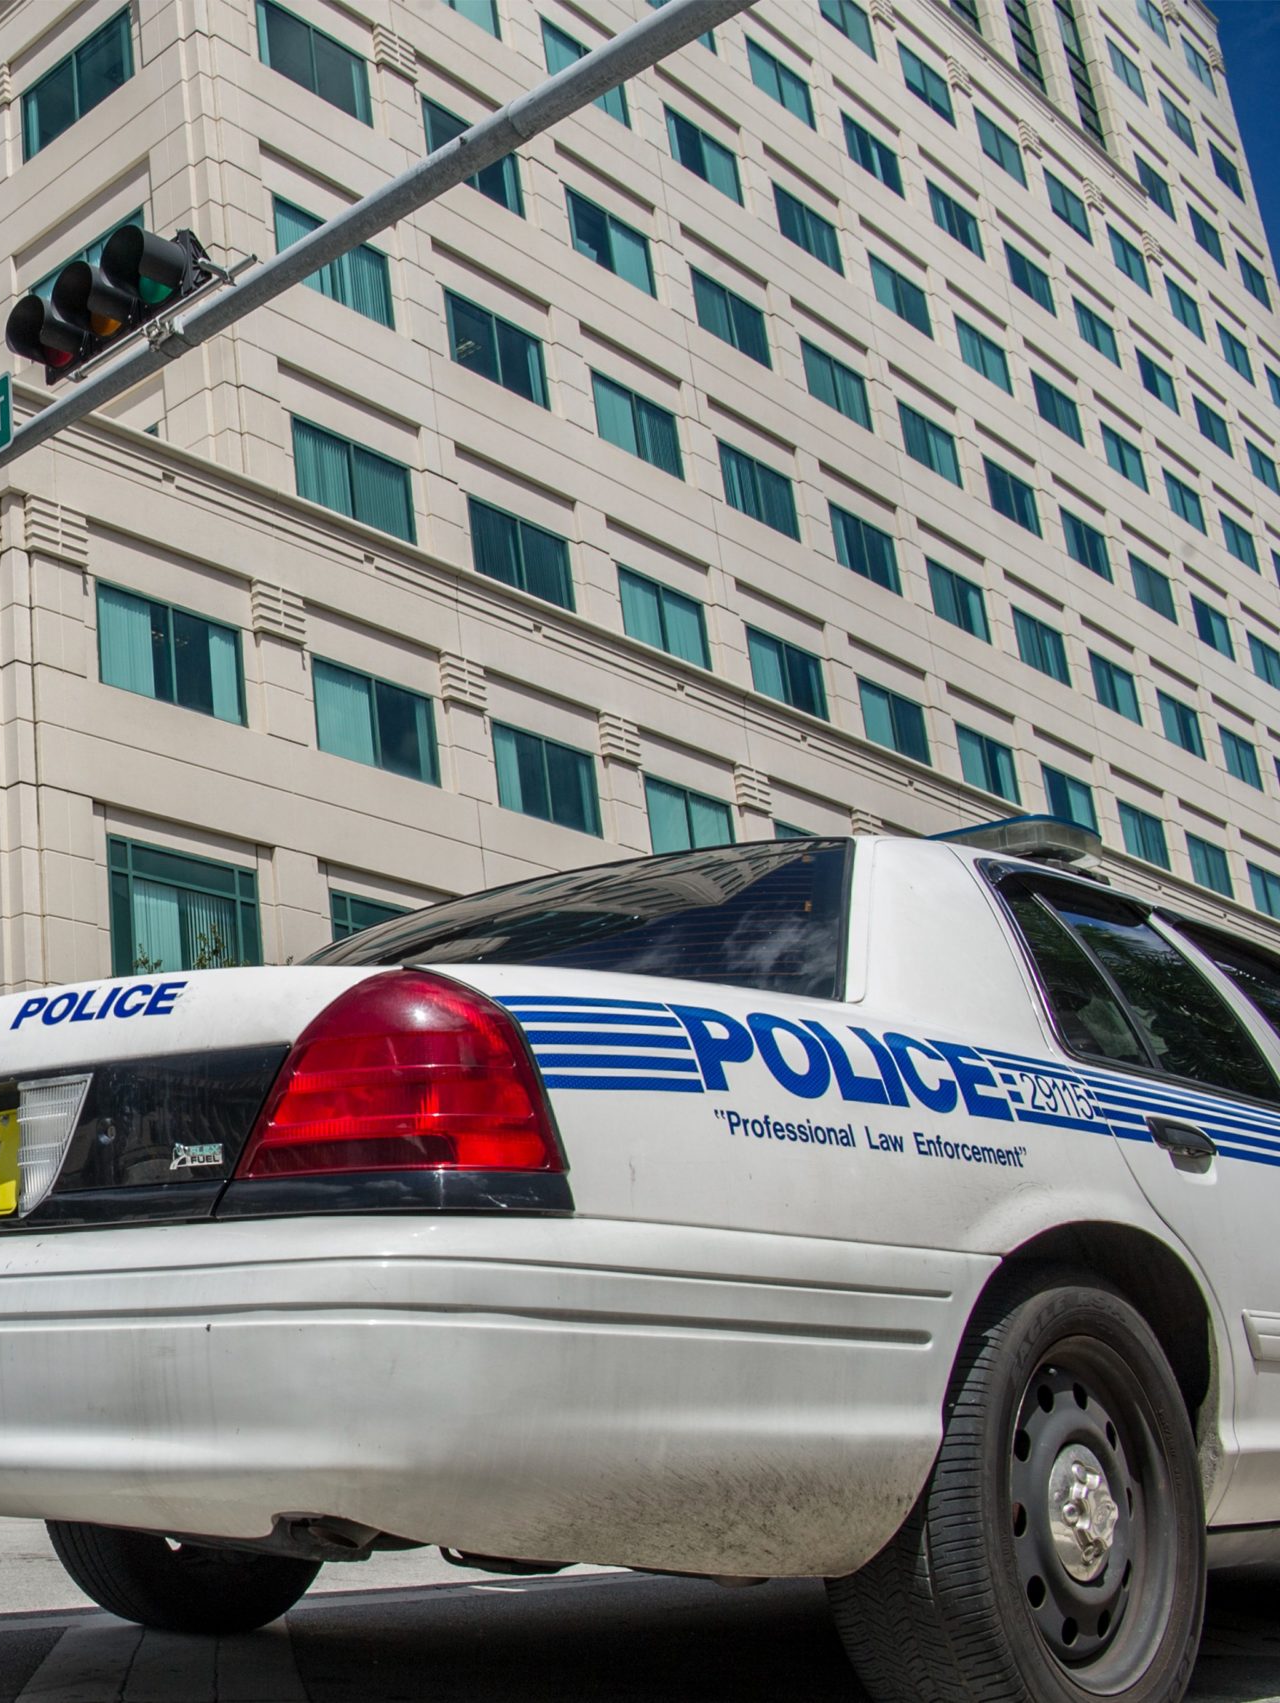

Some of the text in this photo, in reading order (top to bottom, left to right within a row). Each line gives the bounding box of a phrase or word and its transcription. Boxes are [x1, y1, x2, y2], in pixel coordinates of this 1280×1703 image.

[9, 980, 189, 1031] POLICE
[663, 1003, 1096, 1122] POLICE 29115
[190, 1154, 221, 1165] FUEL
[864, 1125, 905, 1154] Law
